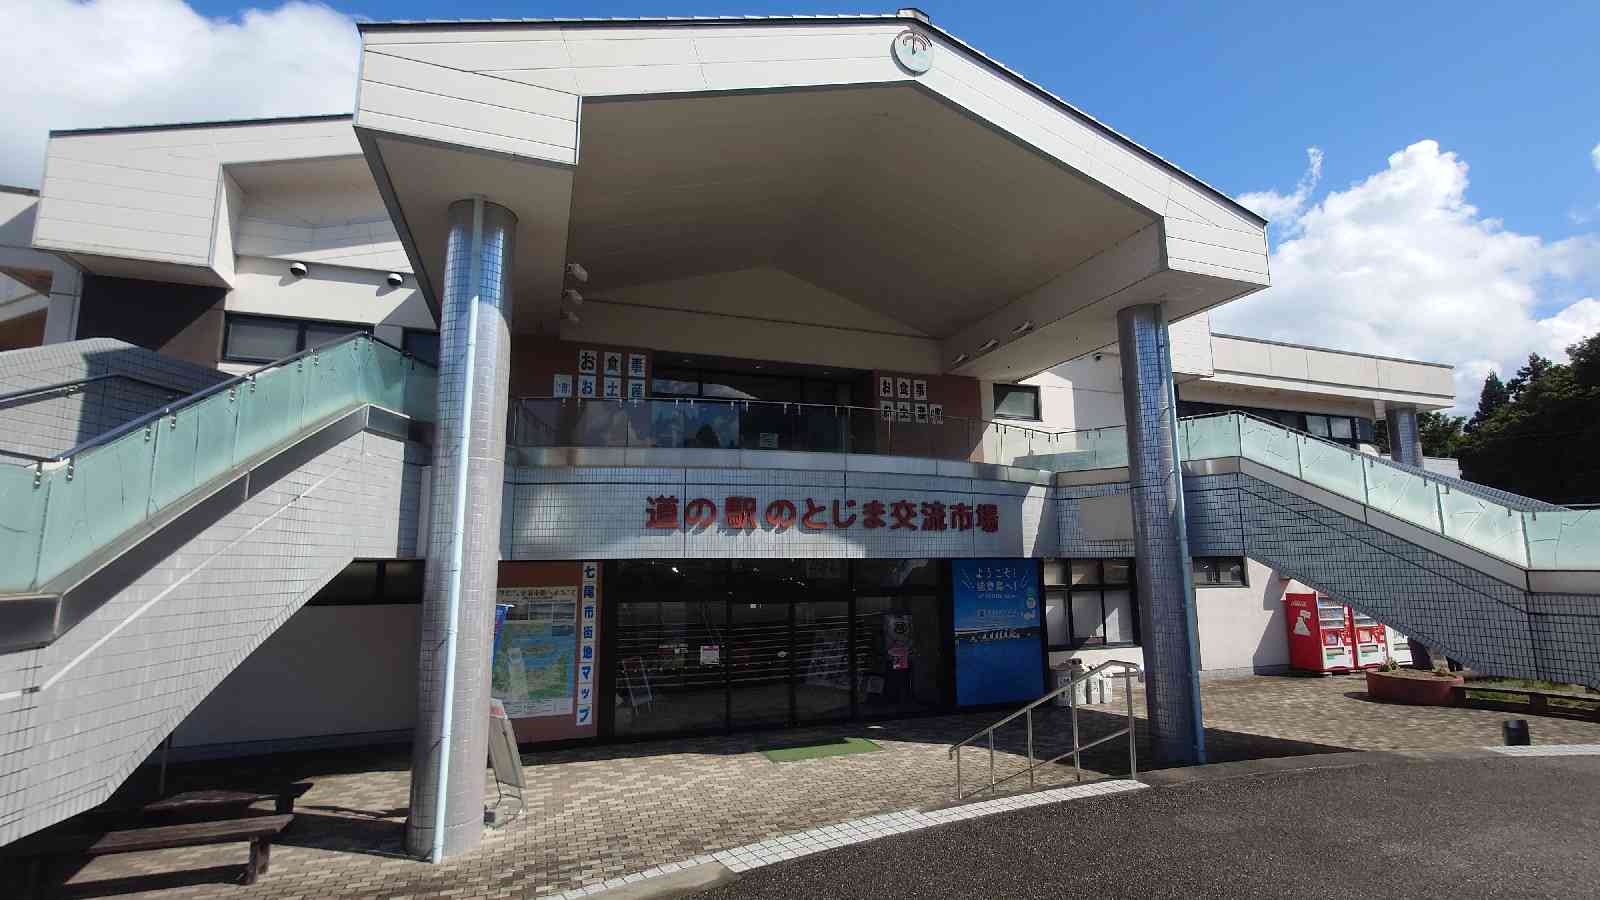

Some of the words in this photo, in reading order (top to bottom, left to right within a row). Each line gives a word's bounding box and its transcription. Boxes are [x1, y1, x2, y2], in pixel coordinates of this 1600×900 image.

[645, 494, 999, 532] 道の駅のとじま交流市場
